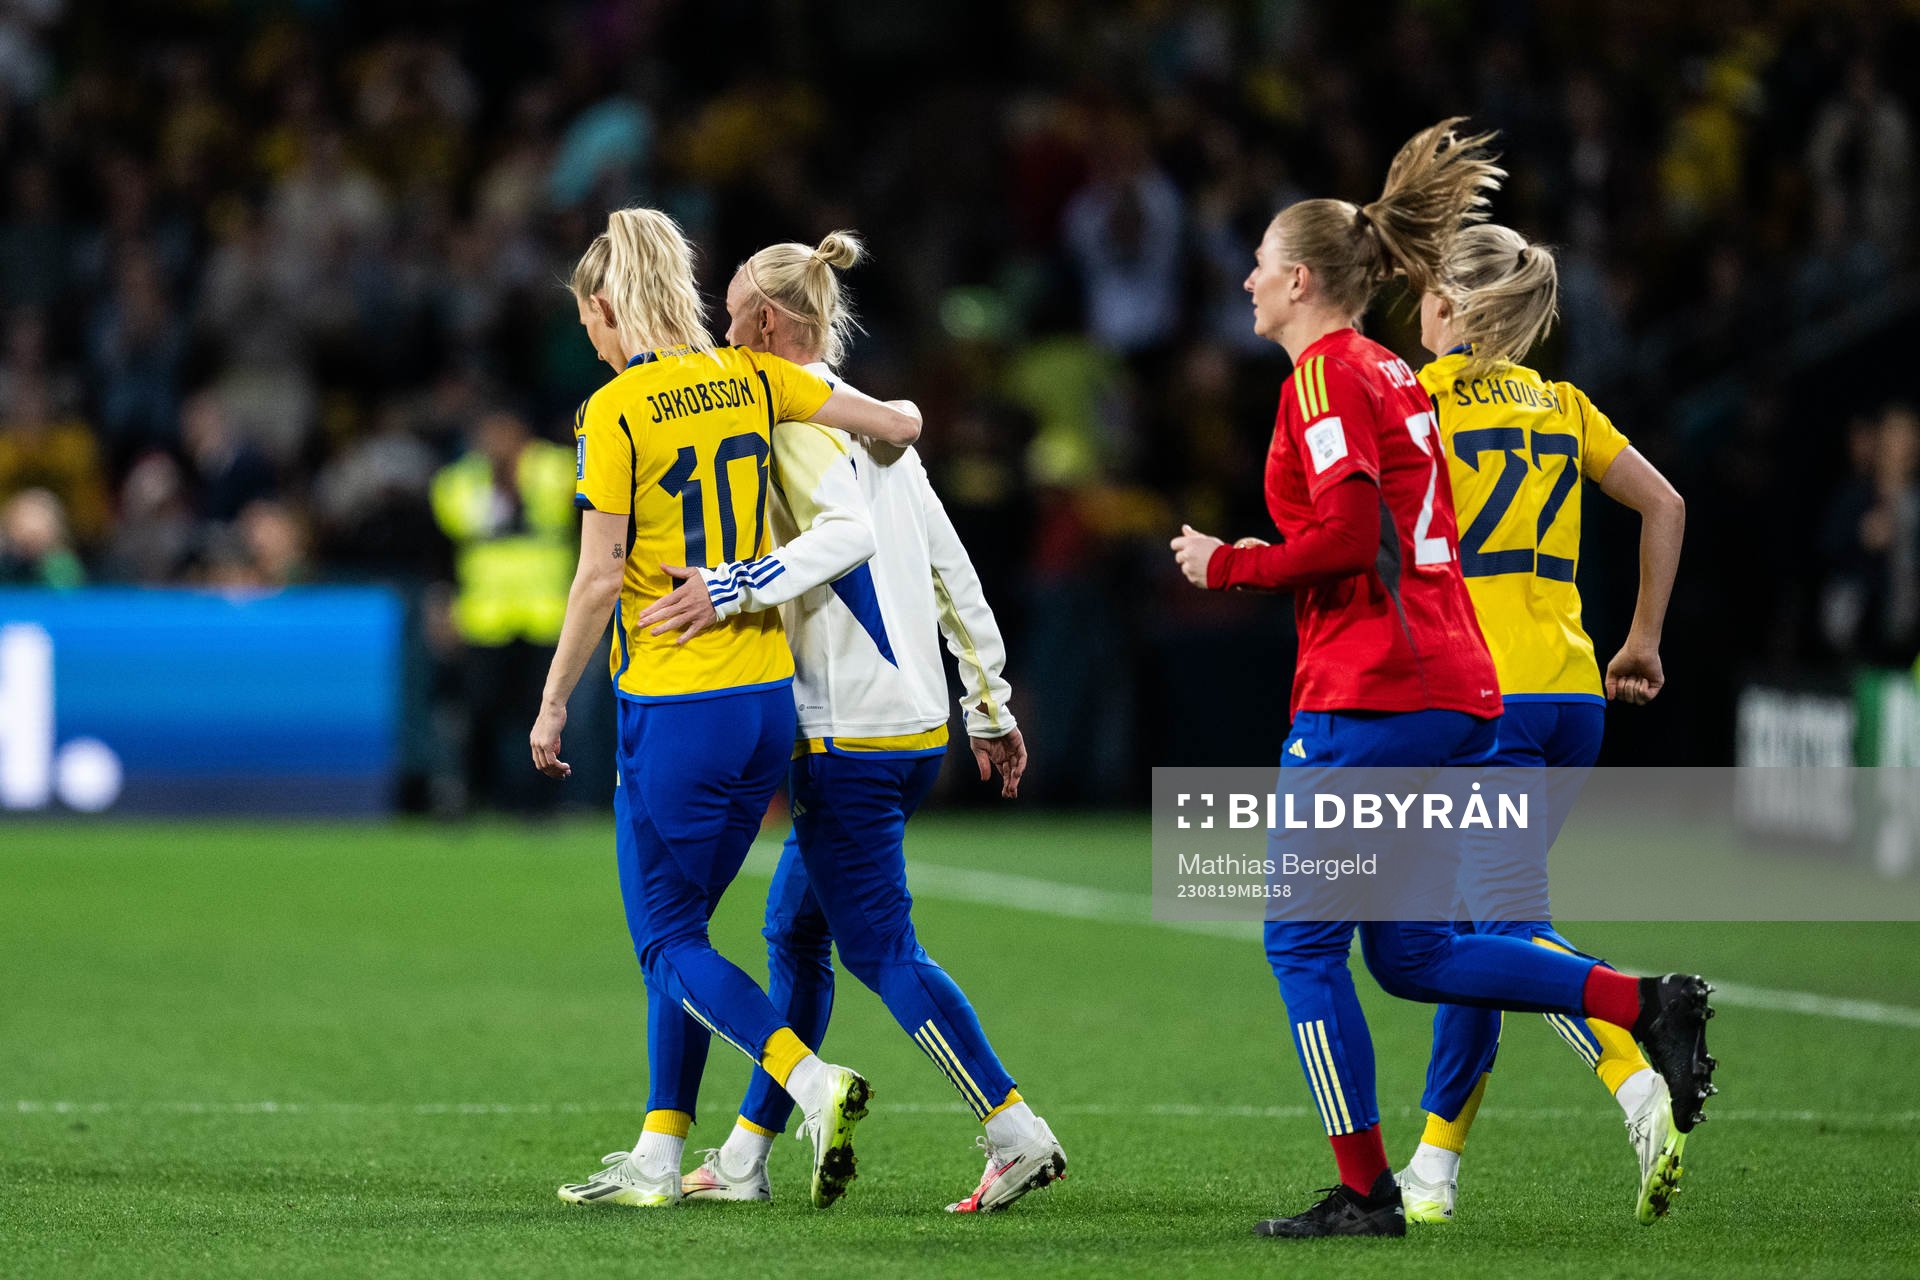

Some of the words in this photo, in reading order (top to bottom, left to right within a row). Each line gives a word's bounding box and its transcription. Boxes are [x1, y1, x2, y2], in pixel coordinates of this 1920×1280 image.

[646, 376, 756, 424] JAKOBSSON
[1454, 378, 1563, 415] SCHOUGH
[657, 431, 770, 572] 10
[1452, 427, 1580, 583] 22
